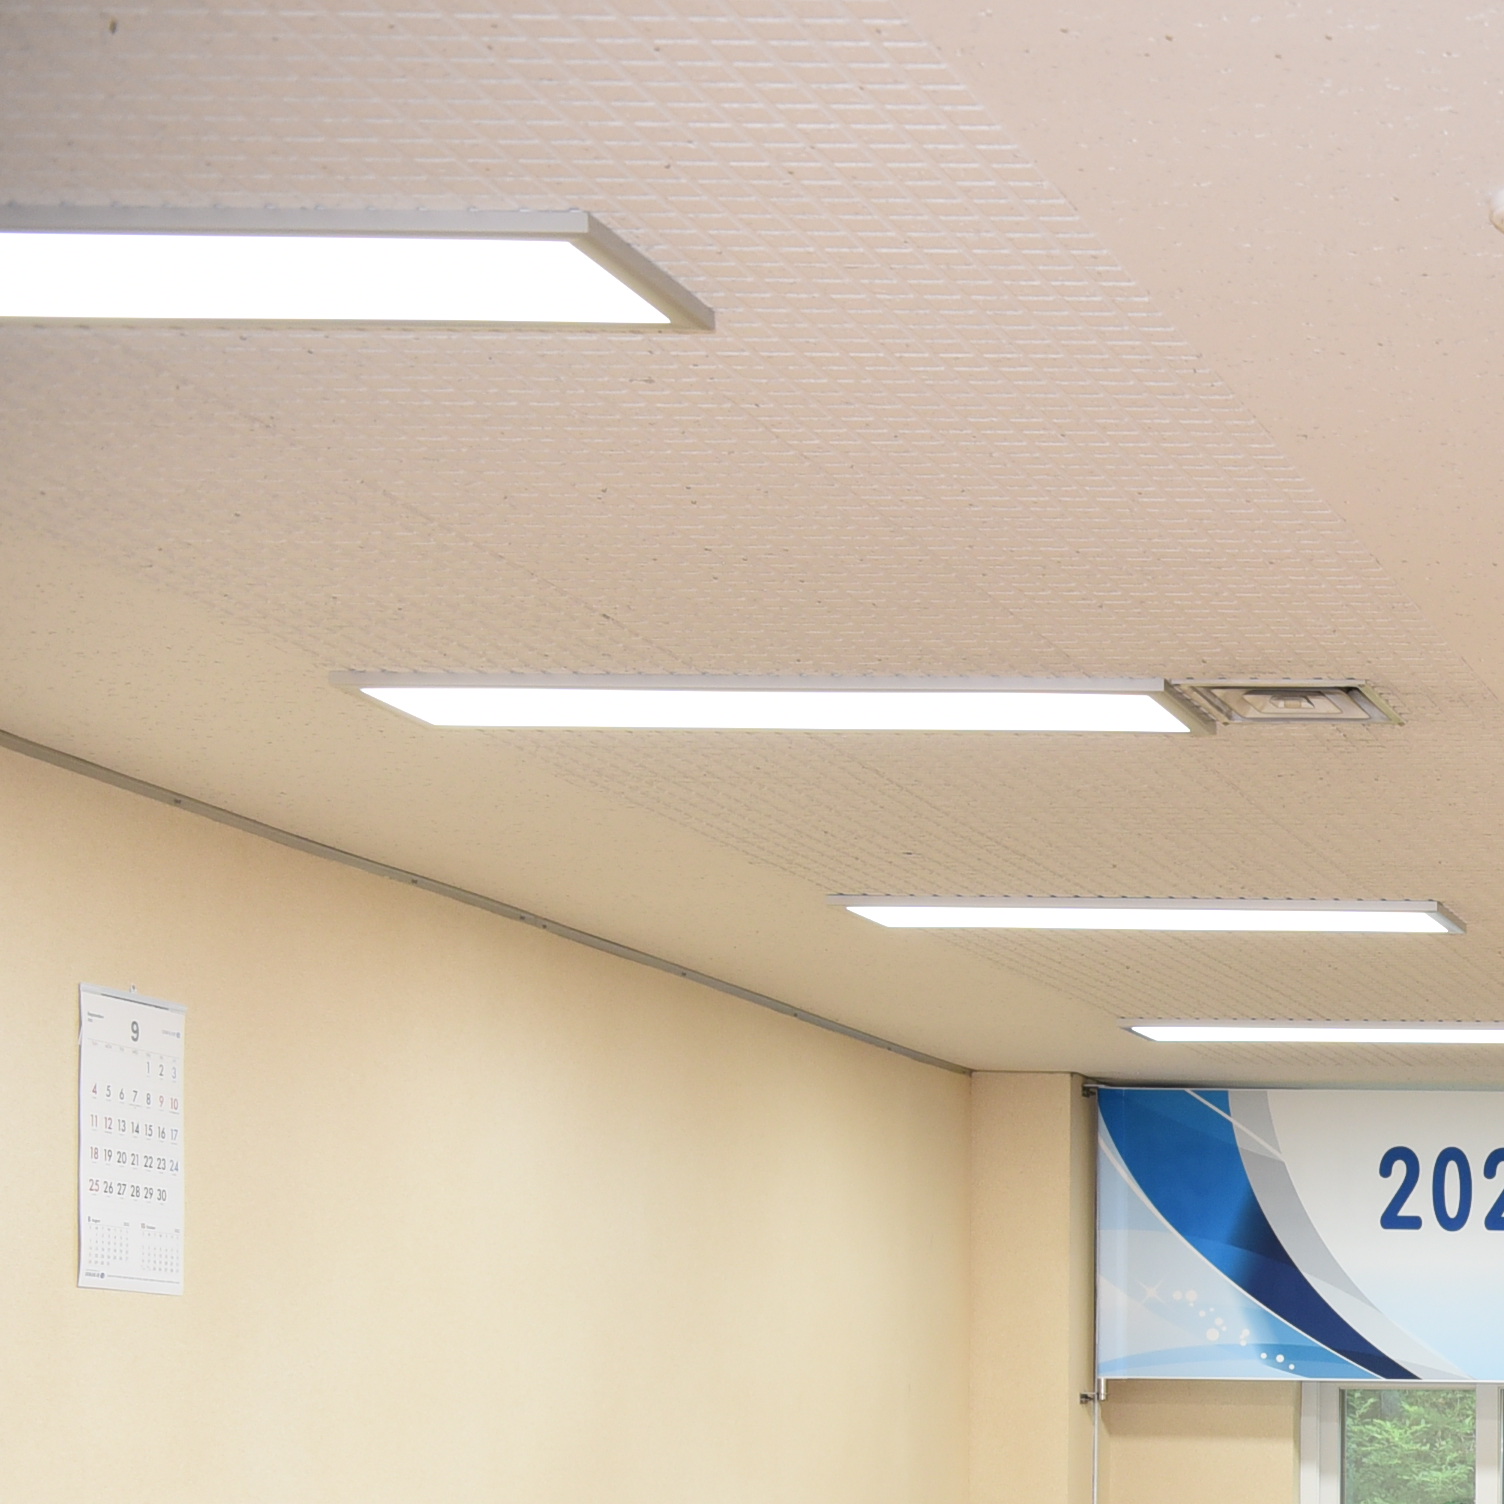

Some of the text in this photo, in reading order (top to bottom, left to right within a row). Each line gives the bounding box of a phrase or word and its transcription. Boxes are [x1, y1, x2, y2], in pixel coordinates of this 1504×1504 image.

[131, 1021, 139, 1042] 9
[146, 1061, 177, 1079] 1 2 3
[92, 1083, 179, 1110] 4 5 6 7 8 9 10
[90, 1114, 178, 1141] 11 12 13 14 15 16 17
[90, 1146, 179, 1172] 18 19 20 21 22 23 24
[89, 1179, 167, 1202] 25 26 27 28 29 30
